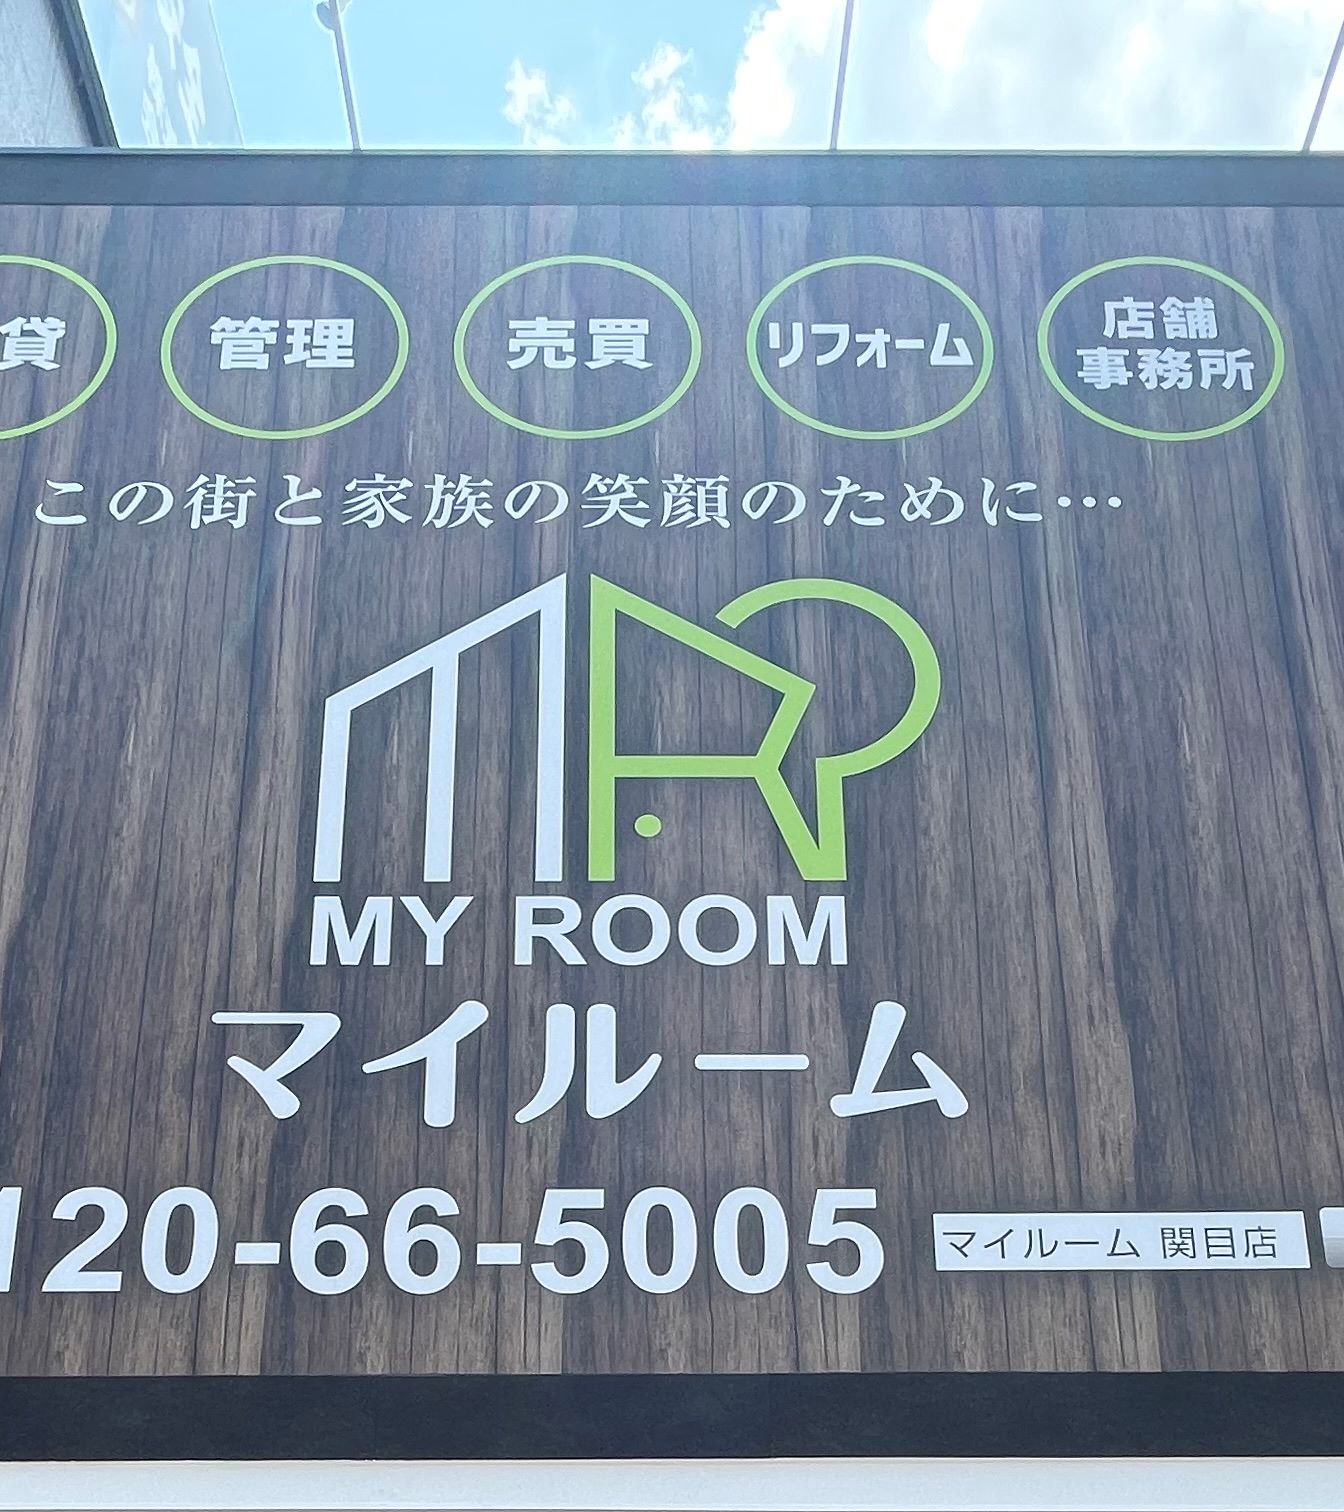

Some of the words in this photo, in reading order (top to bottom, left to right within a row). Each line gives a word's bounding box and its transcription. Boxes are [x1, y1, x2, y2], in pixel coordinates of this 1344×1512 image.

[210, 316, 355, 370] 管理
[507, 316, 653, 370] 売買
[1103, 297, 1218, 340] 店舗
[767, 320, 975, 369] リフォーム
[1076, 346, 1257, 392] 事務所
[310, 895, 474, 966] MY
[515, 894, 848, 967] ROOM
[211, 1000, 969, 1129] マイルーム
[942, 1228, 1140, 1259] マイルーム
[1161, 1226, 1279, 1259] 関目店
